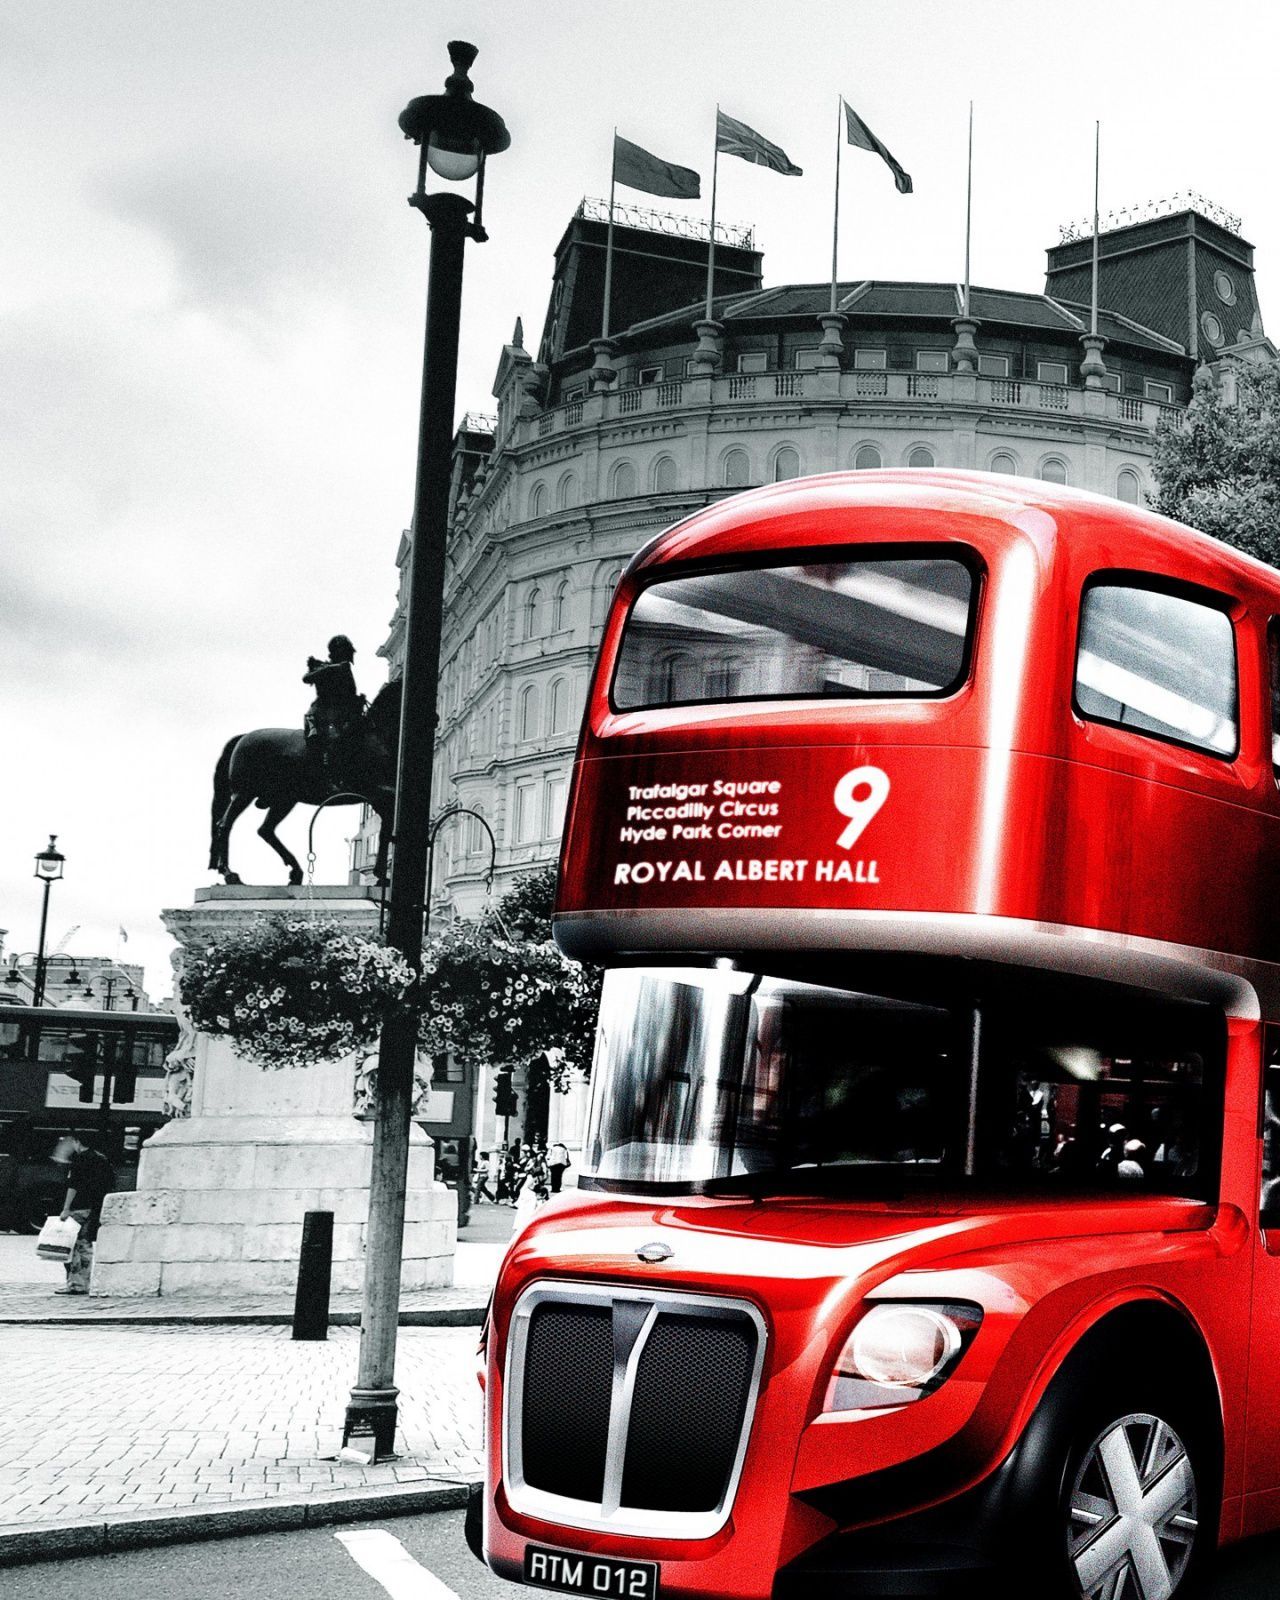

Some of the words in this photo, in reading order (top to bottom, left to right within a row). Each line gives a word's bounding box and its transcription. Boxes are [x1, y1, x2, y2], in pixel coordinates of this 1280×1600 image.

[629, 782, 708, 800] Trafalgar
[713, 780, 782, 798] Square
[627, 802, 714, 821] Piccadilly
[719, 801, 779, 817] Circus
[833, 765, 890, 851] 9
[620, 826, 667, 845] Hyde
[672, 824, 713, 840] Park
[717, 823, 782, 839] Corner
[614, 860, 706, 885] ROYAL
[714, 859, 808, 881] ALBERT
[815, 860, 880, 884] HALL
[530, 1552, 584, 1587] RTM
[592, 1564, 647, 1598] 012
